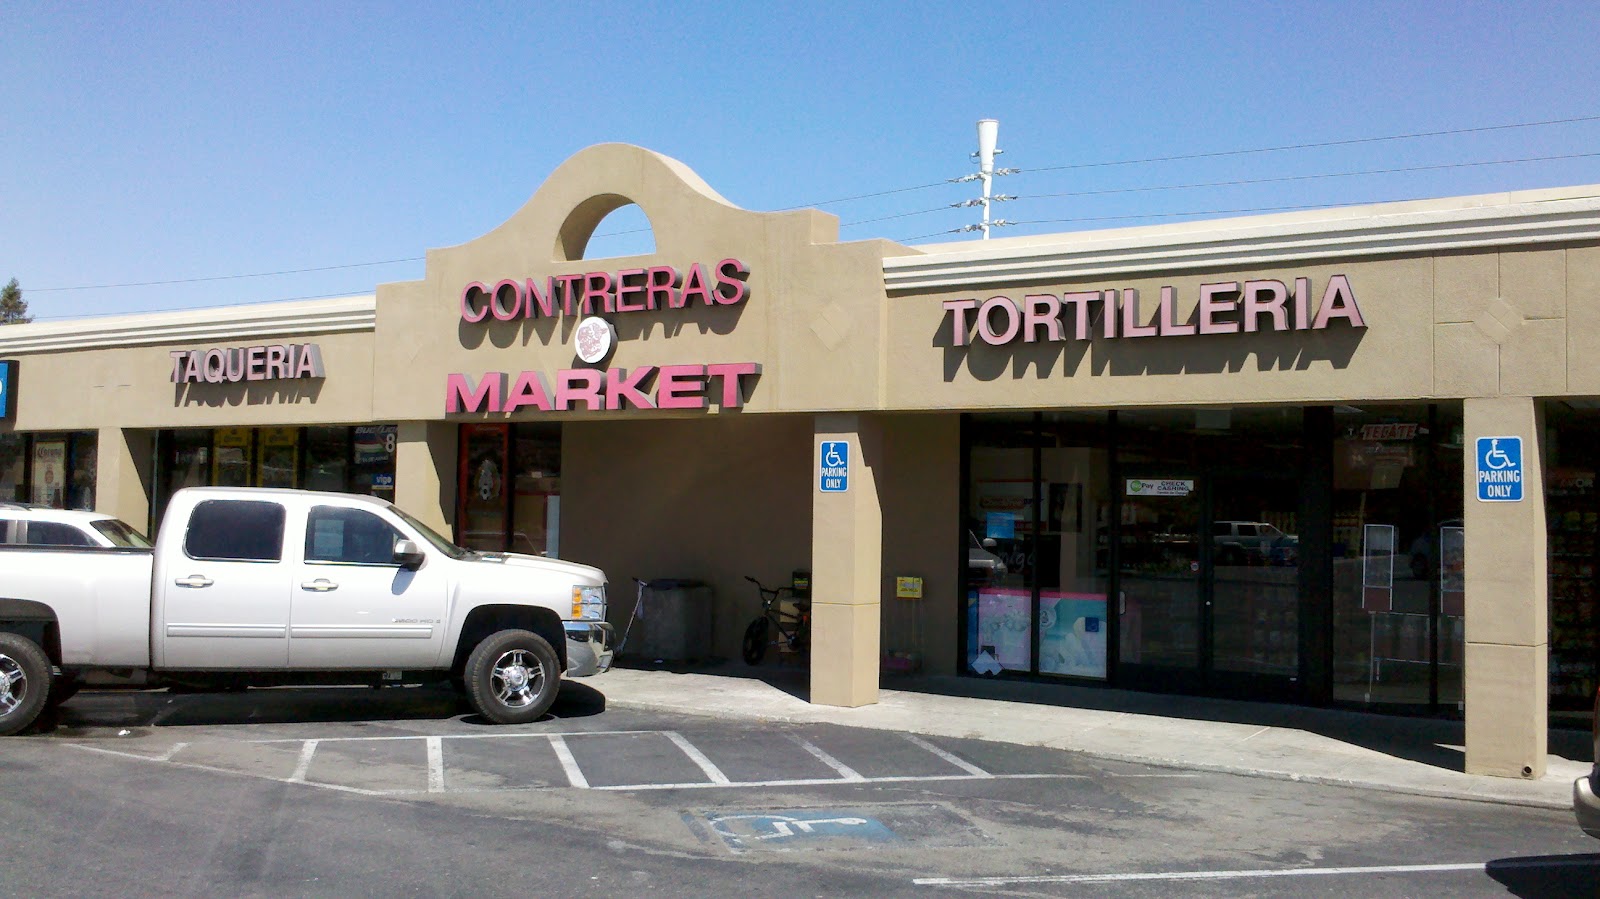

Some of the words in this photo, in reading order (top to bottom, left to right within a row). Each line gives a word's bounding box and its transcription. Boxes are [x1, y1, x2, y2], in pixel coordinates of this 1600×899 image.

[459, 258, 750, 323] CONTRERAS
[942, 274, 1366, 347] TORTILLERIA
[170, 343, 321, 383] TAQUERIA
[446, 362, 758, 413] MARKET
[1363, 424, 1417, 440] TECATE
[821, 467, 847, 478] PARKING
[1479, 470, 1520, 483] PARKING
[825, 478, 842, 489] ONLY
[1487, 484, 1512, 497] ONLY
